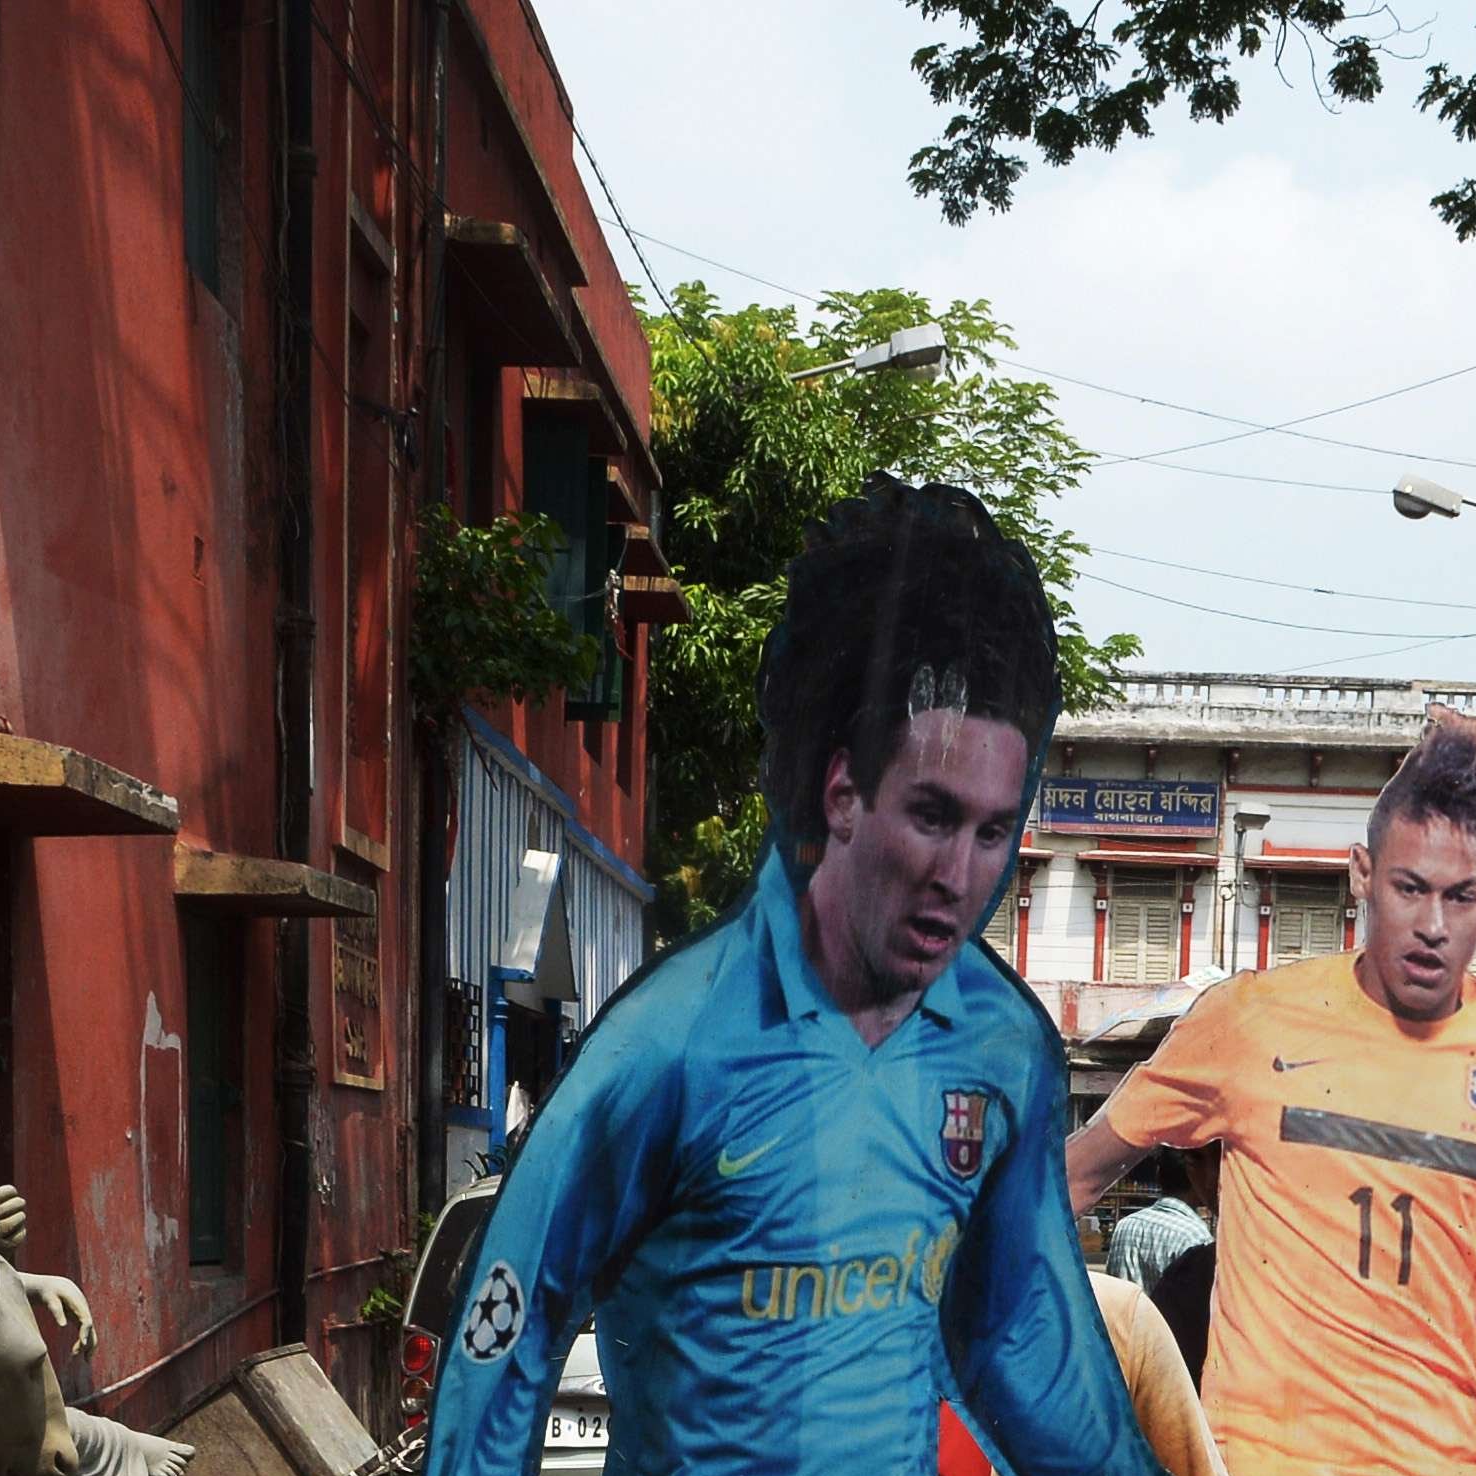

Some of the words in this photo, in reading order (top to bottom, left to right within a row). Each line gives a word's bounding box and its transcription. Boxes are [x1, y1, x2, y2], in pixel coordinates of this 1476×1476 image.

[1095, 789, 1153, 811] মোহন
[1160, 785, 1215, 814] মন্দির
[741, 1222, 922, 1320] unicef
[1348, 1186, 1413, 1286] 11
